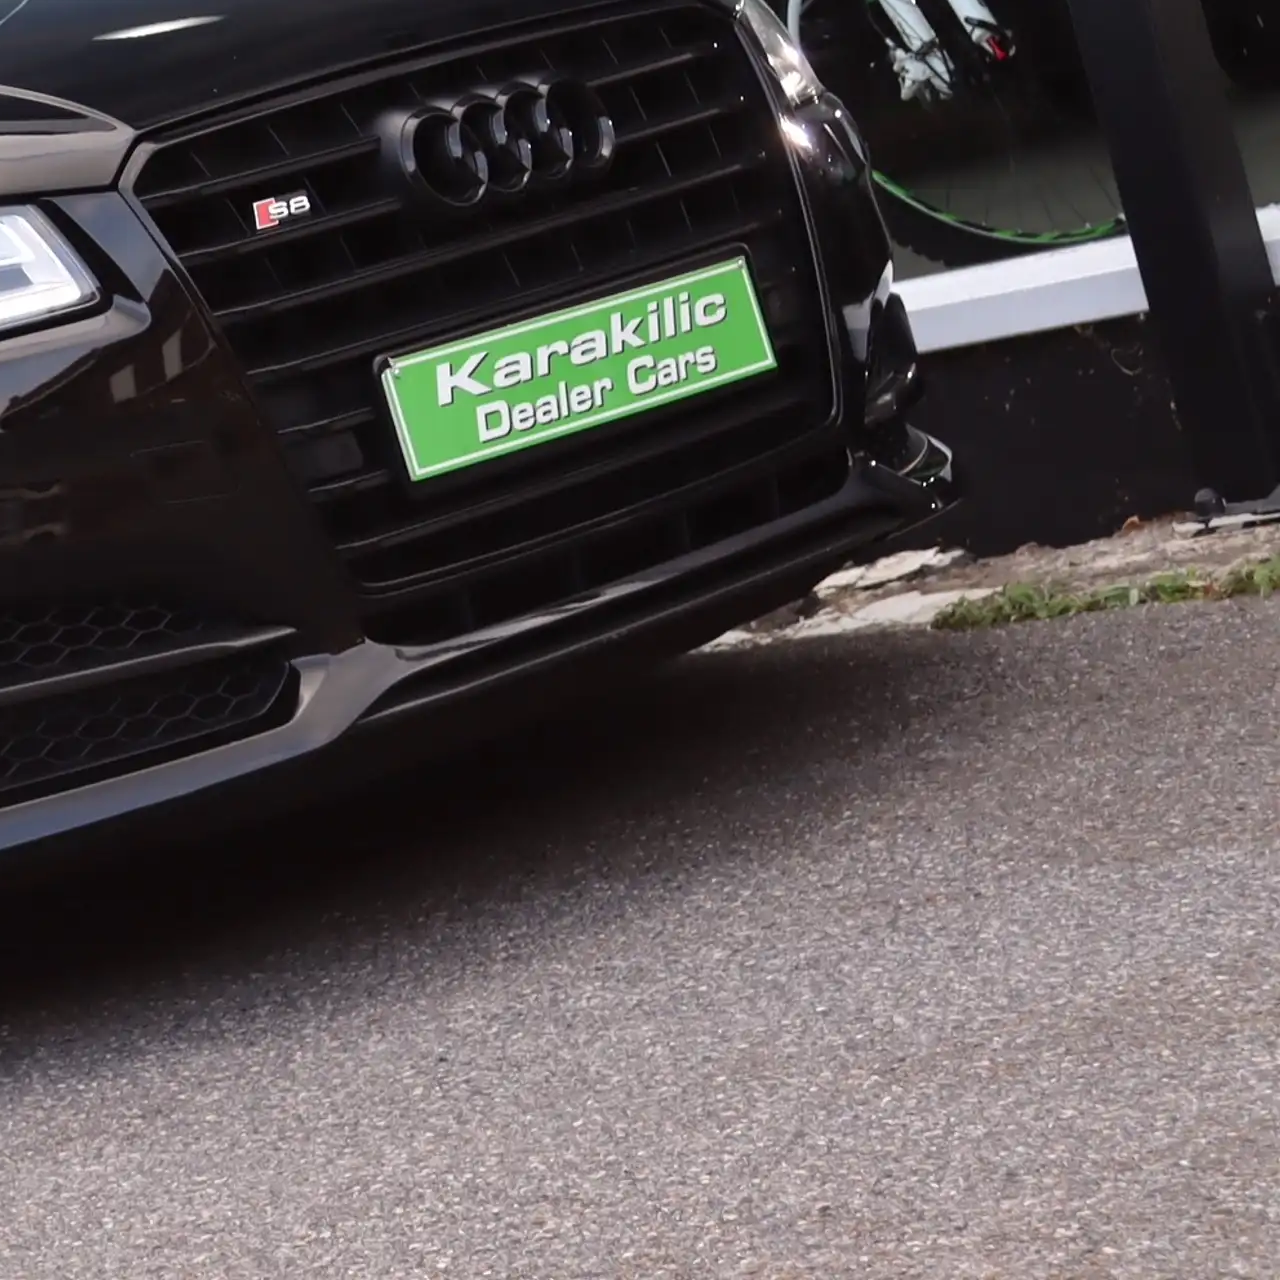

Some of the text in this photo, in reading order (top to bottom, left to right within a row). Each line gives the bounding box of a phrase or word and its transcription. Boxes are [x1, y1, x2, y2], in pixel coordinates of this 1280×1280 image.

[268, 195, 311, 220] S8
[435, 291, 728, 407] Karakilic
[476, 344, 718, 444] Dealer Cars
